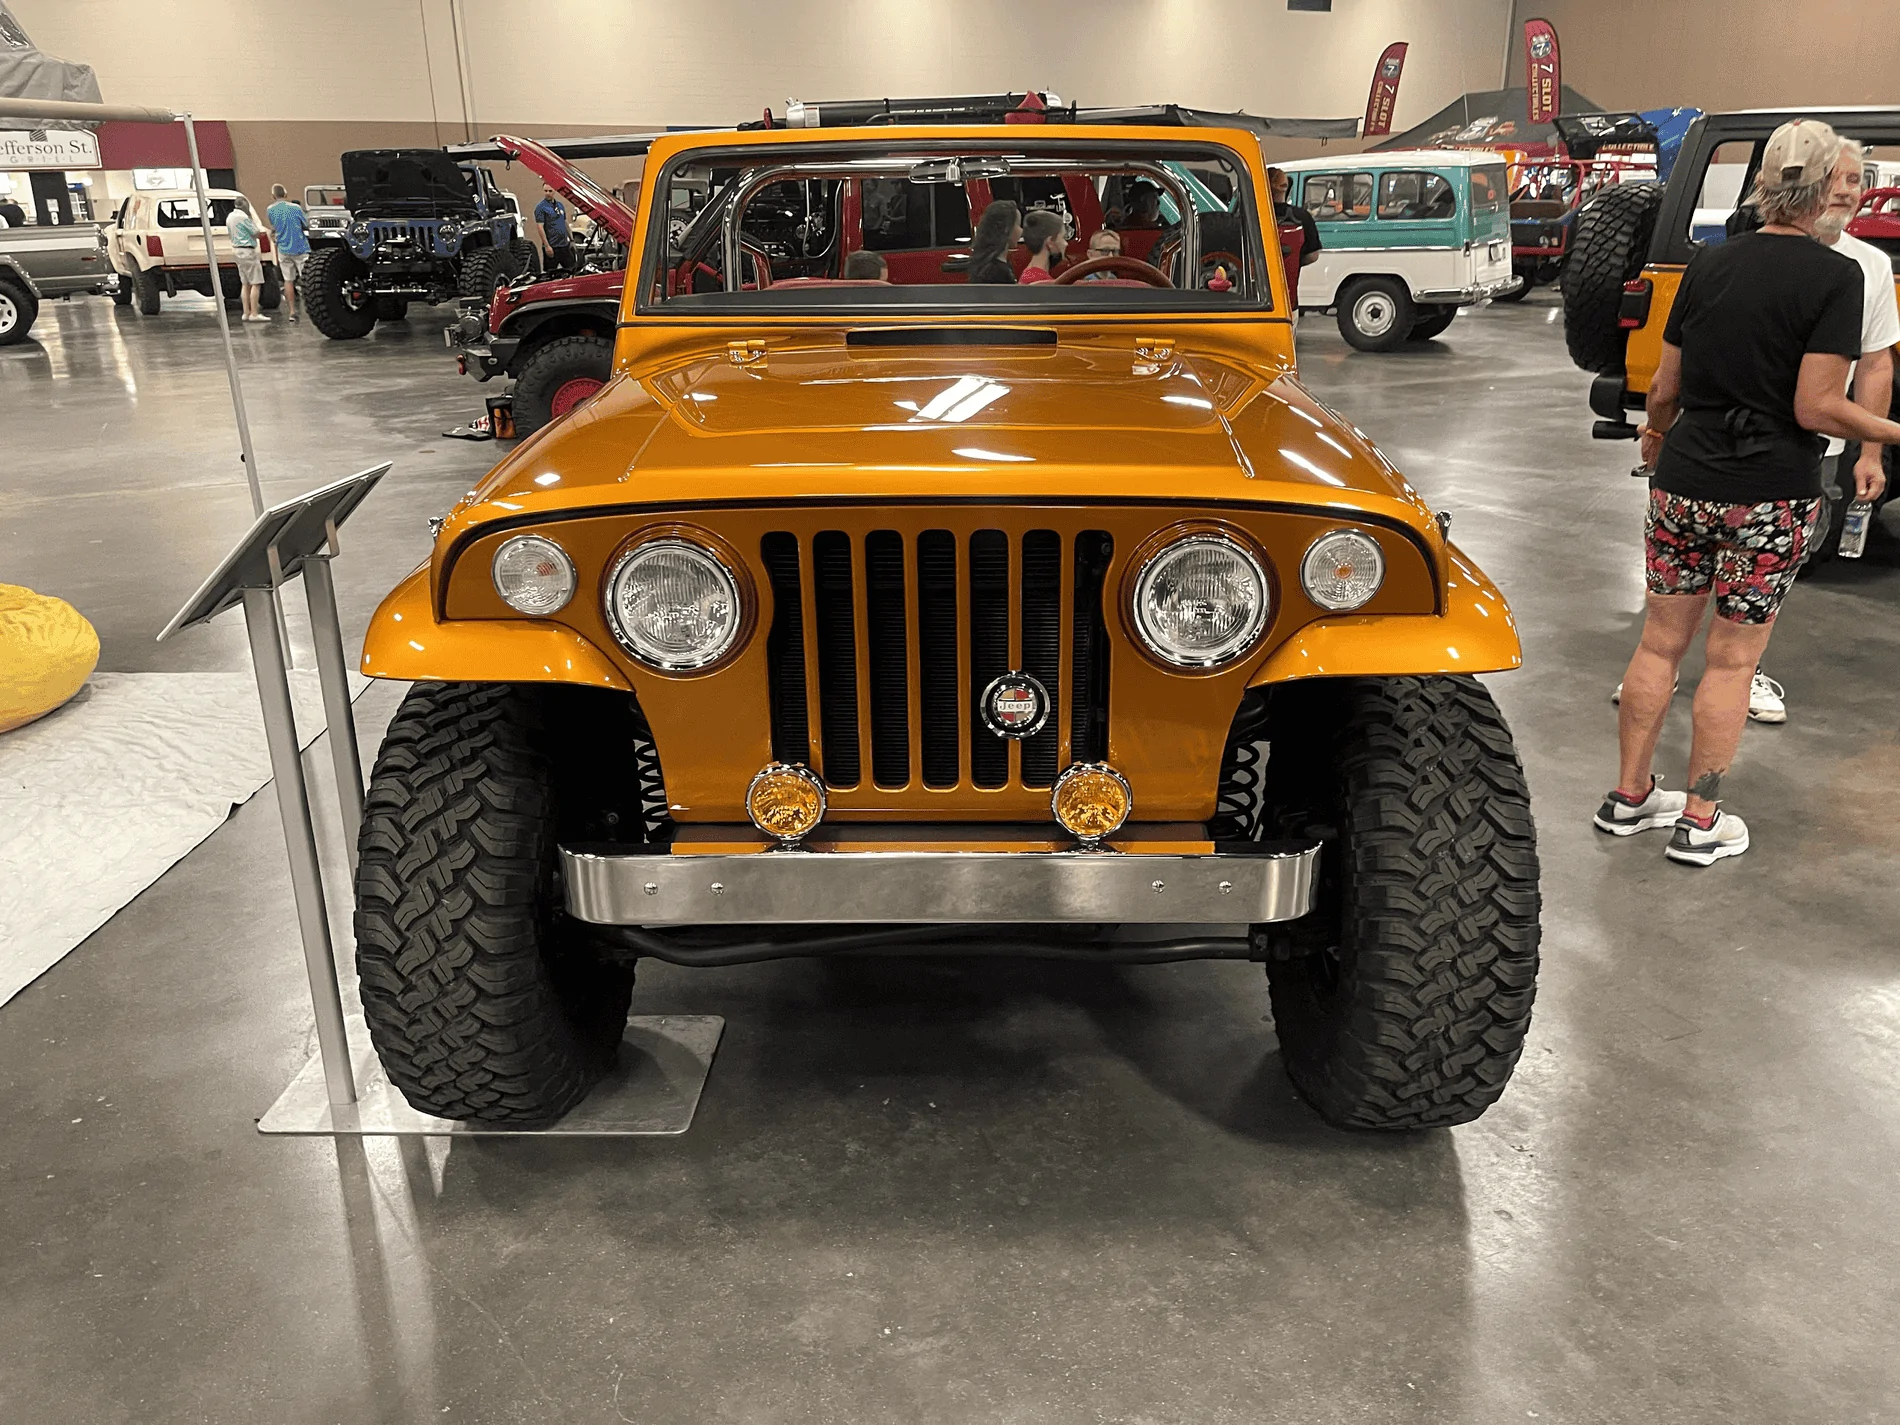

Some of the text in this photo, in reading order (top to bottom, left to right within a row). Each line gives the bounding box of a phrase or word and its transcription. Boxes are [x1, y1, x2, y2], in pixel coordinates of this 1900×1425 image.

[1540, 63, 1554, 112] 7 SLOT
[1378, 84, 1395, 129] 7 SLOT
[69, 139, 93, 154] St.
[556, 186, 595, 215] Red
[999, 702, 1031, 711] Jeep
